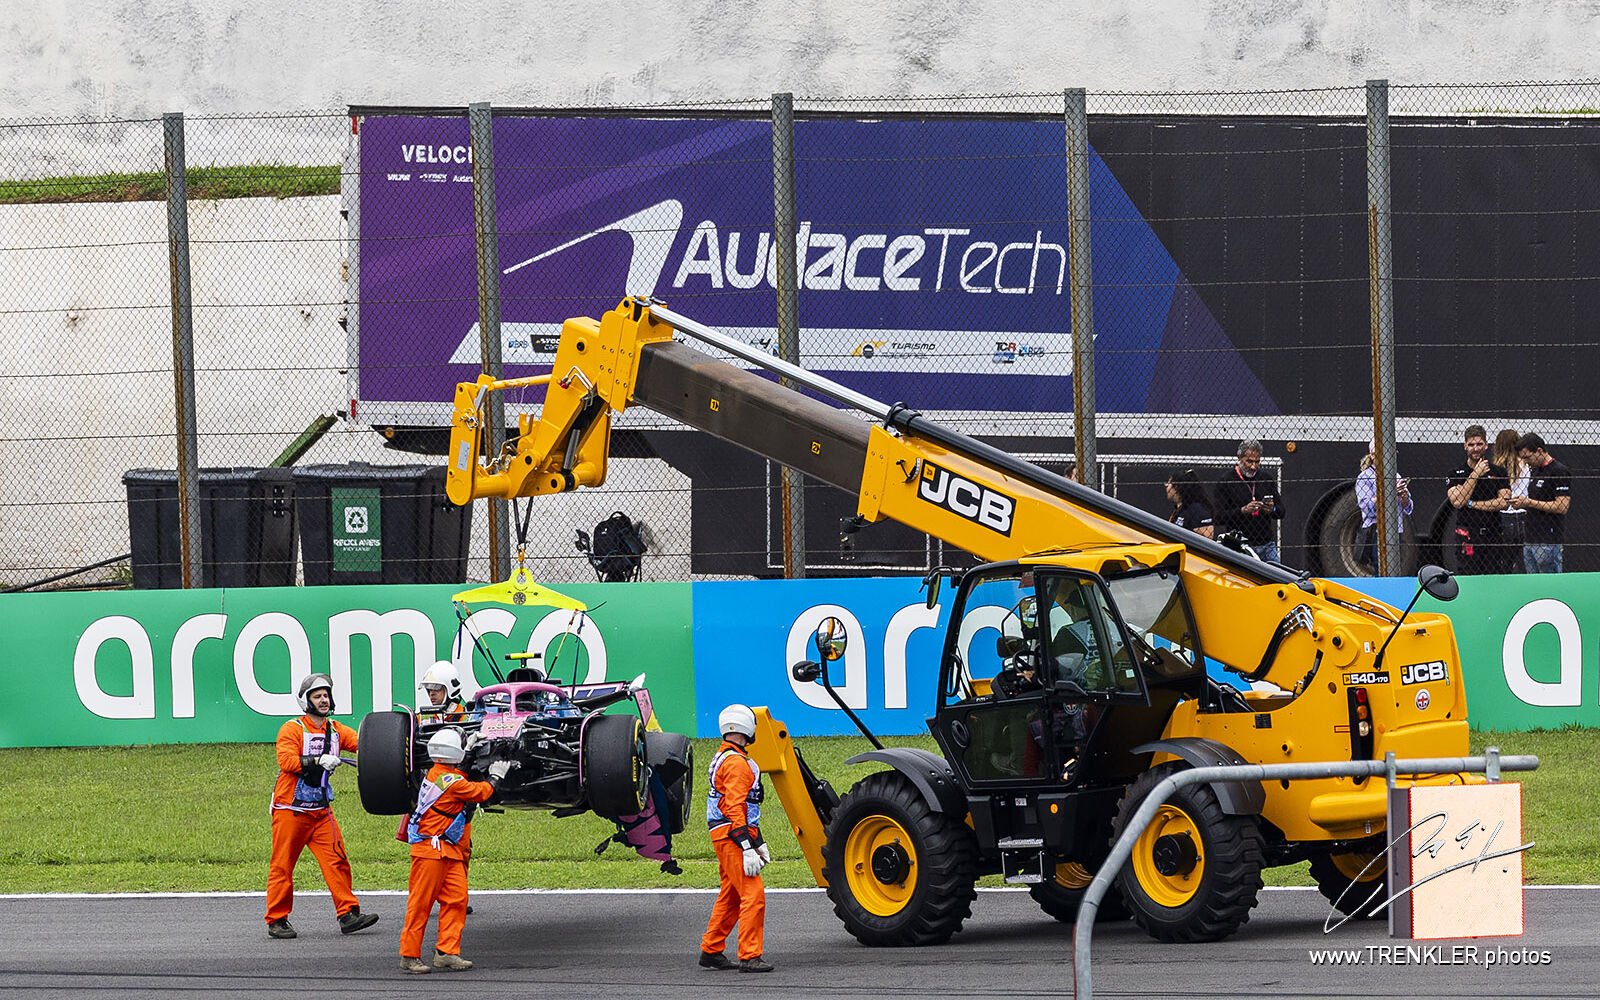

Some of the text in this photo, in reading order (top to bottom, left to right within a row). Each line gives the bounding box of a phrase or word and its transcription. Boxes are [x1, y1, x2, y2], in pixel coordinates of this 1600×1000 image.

[996, 342, 1017, 351] TCR
[921, 470, 1012, 532] JCB
[73, 608, 608, 719] aramco
[1402, 661, 1444, 684] JCB
[1350, 673, 1389, 684] 540-170
